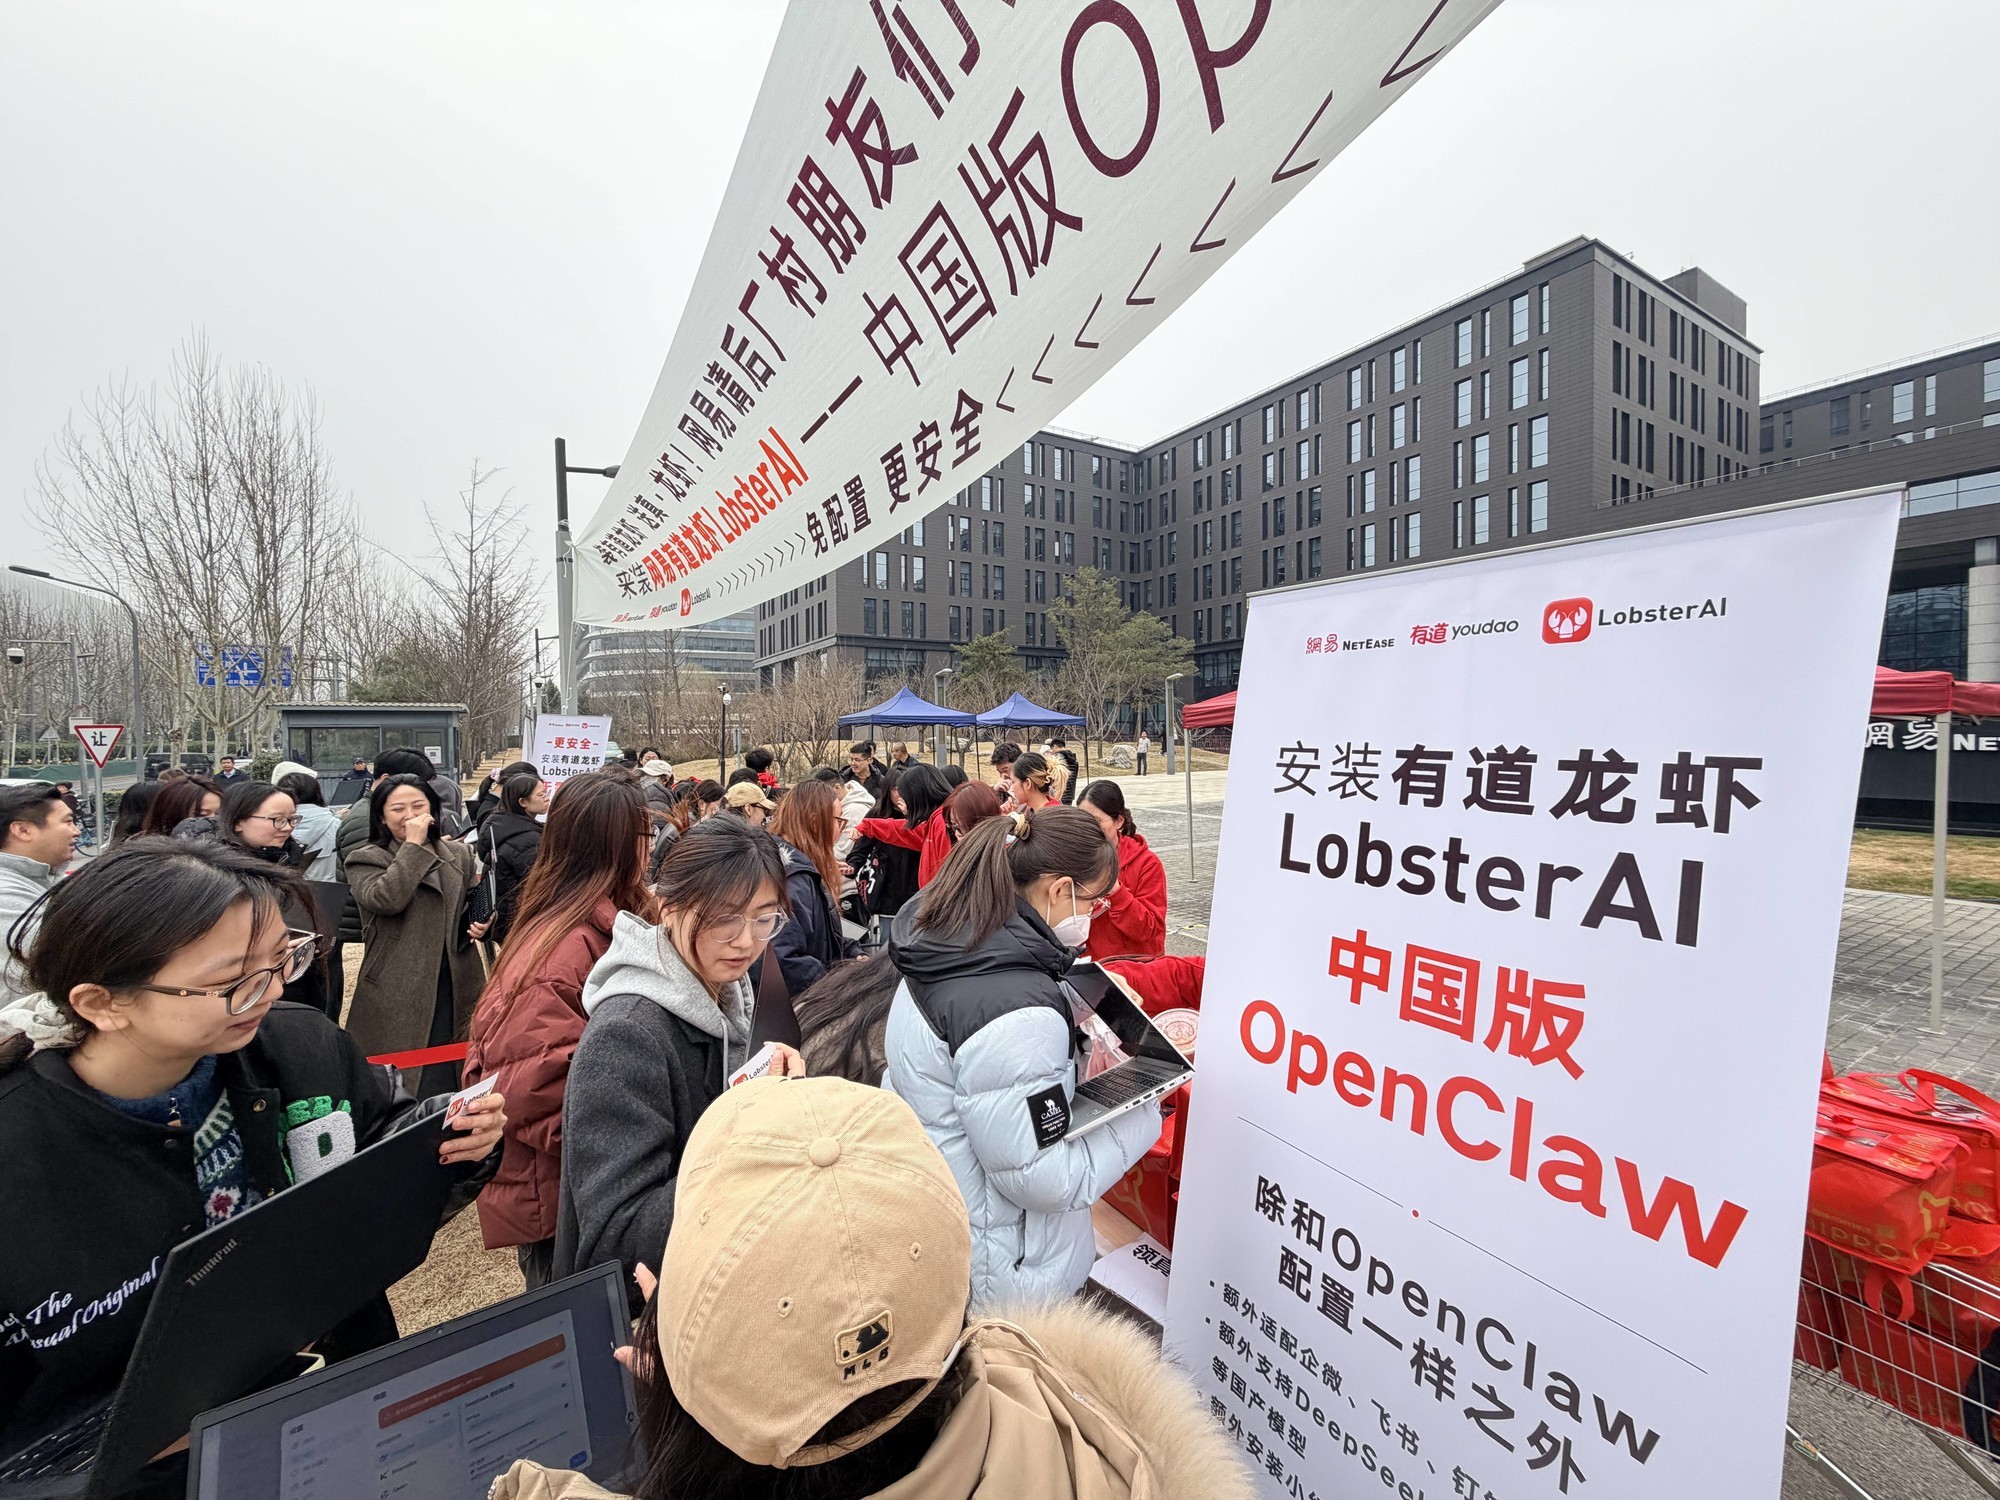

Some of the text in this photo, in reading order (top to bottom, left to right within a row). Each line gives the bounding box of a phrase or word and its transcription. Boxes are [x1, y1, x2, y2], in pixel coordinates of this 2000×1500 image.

[691, 587, 711, 606] LobsterAI
[806, 474, 872, 559] 免配置
[880, 388, 985, 514] 更安全
[1305, 633, 1339, 655] 網易
[1410, 622, 1449, 645] 有道
[1450, 617, 1520, 642] youdao
[1598, 597, 1728, 627] LobsterAI
[90, 731, 108, 747] 让
[541, 754, 601, 766] 安装有道龙虾
[1272, 739, 1763, 835] 安装有道龙虾
[1953, 733, 2000, 751] NE
[1279, 812, 1704, 948] LobsterAI
[1327, 928, 1587, 1081] 中国版
[1041, 1107, 1062, 1120] CAMEL
[1239, 999, 1749, 1270] OpenClaw
[81, 1255, 160, 1325] Original
[184, 1238, 238, 1286] ThinkPad
[843, 1346, 889, 1380] MLB
[1254, 1175, 1661, 1466] 除和OpenClaw
[1277, 1244, 1588, 1496] 配置一样之外
[1210, 1394, 1321, 1500] 额外安装小
[1211, 1354, 1307, 1461] 等国产模型
[1217, 1319, 1425, 1500] 额外支持DeepSee
